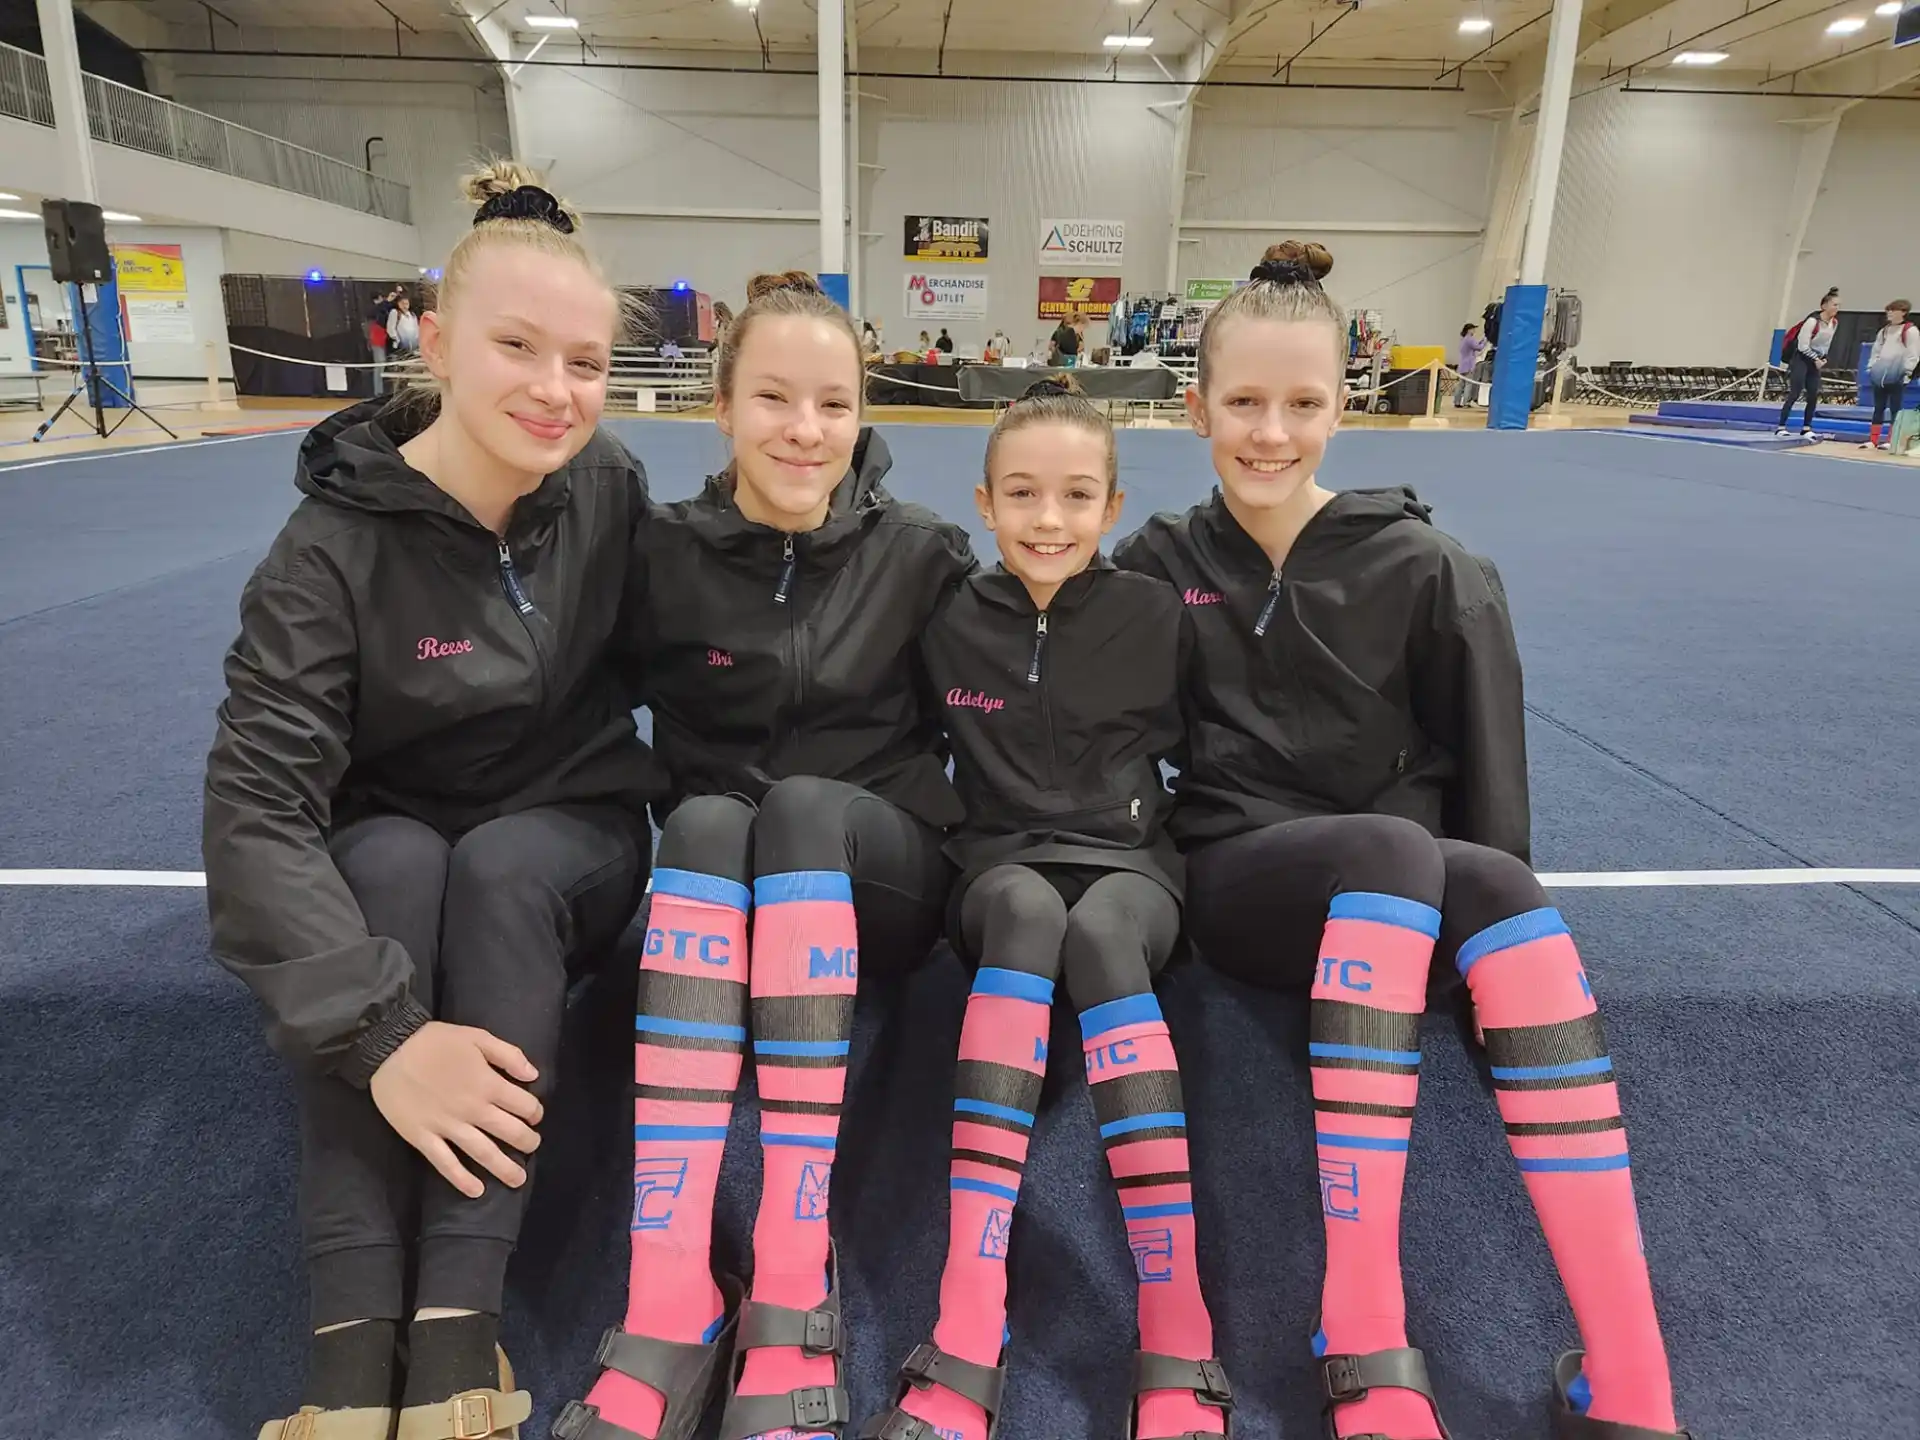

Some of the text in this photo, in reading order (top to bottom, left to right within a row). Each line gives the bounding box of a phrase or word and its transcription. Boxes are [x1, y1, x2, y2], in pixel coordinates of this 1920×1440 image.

[932, 220, 979, 237] Bandit
[1063, 223, 1123, 238] DOEHRING
[1068, 240, 1123, 254] SCHULTZ
[907, 275, 985, 290] MERCHANDISE
[921, 291, 965, 306] OUTLET
[1040, 302, 1074, 313] CENTRAL
[1078, 303, 1112, 313] MICHIGA
[416, 636, 474, 660] Reese
[707, 648, 734, 667] Bri
[946, 687, 1005, 714] Adelyn
[645, 928, 730, 967] GTC
